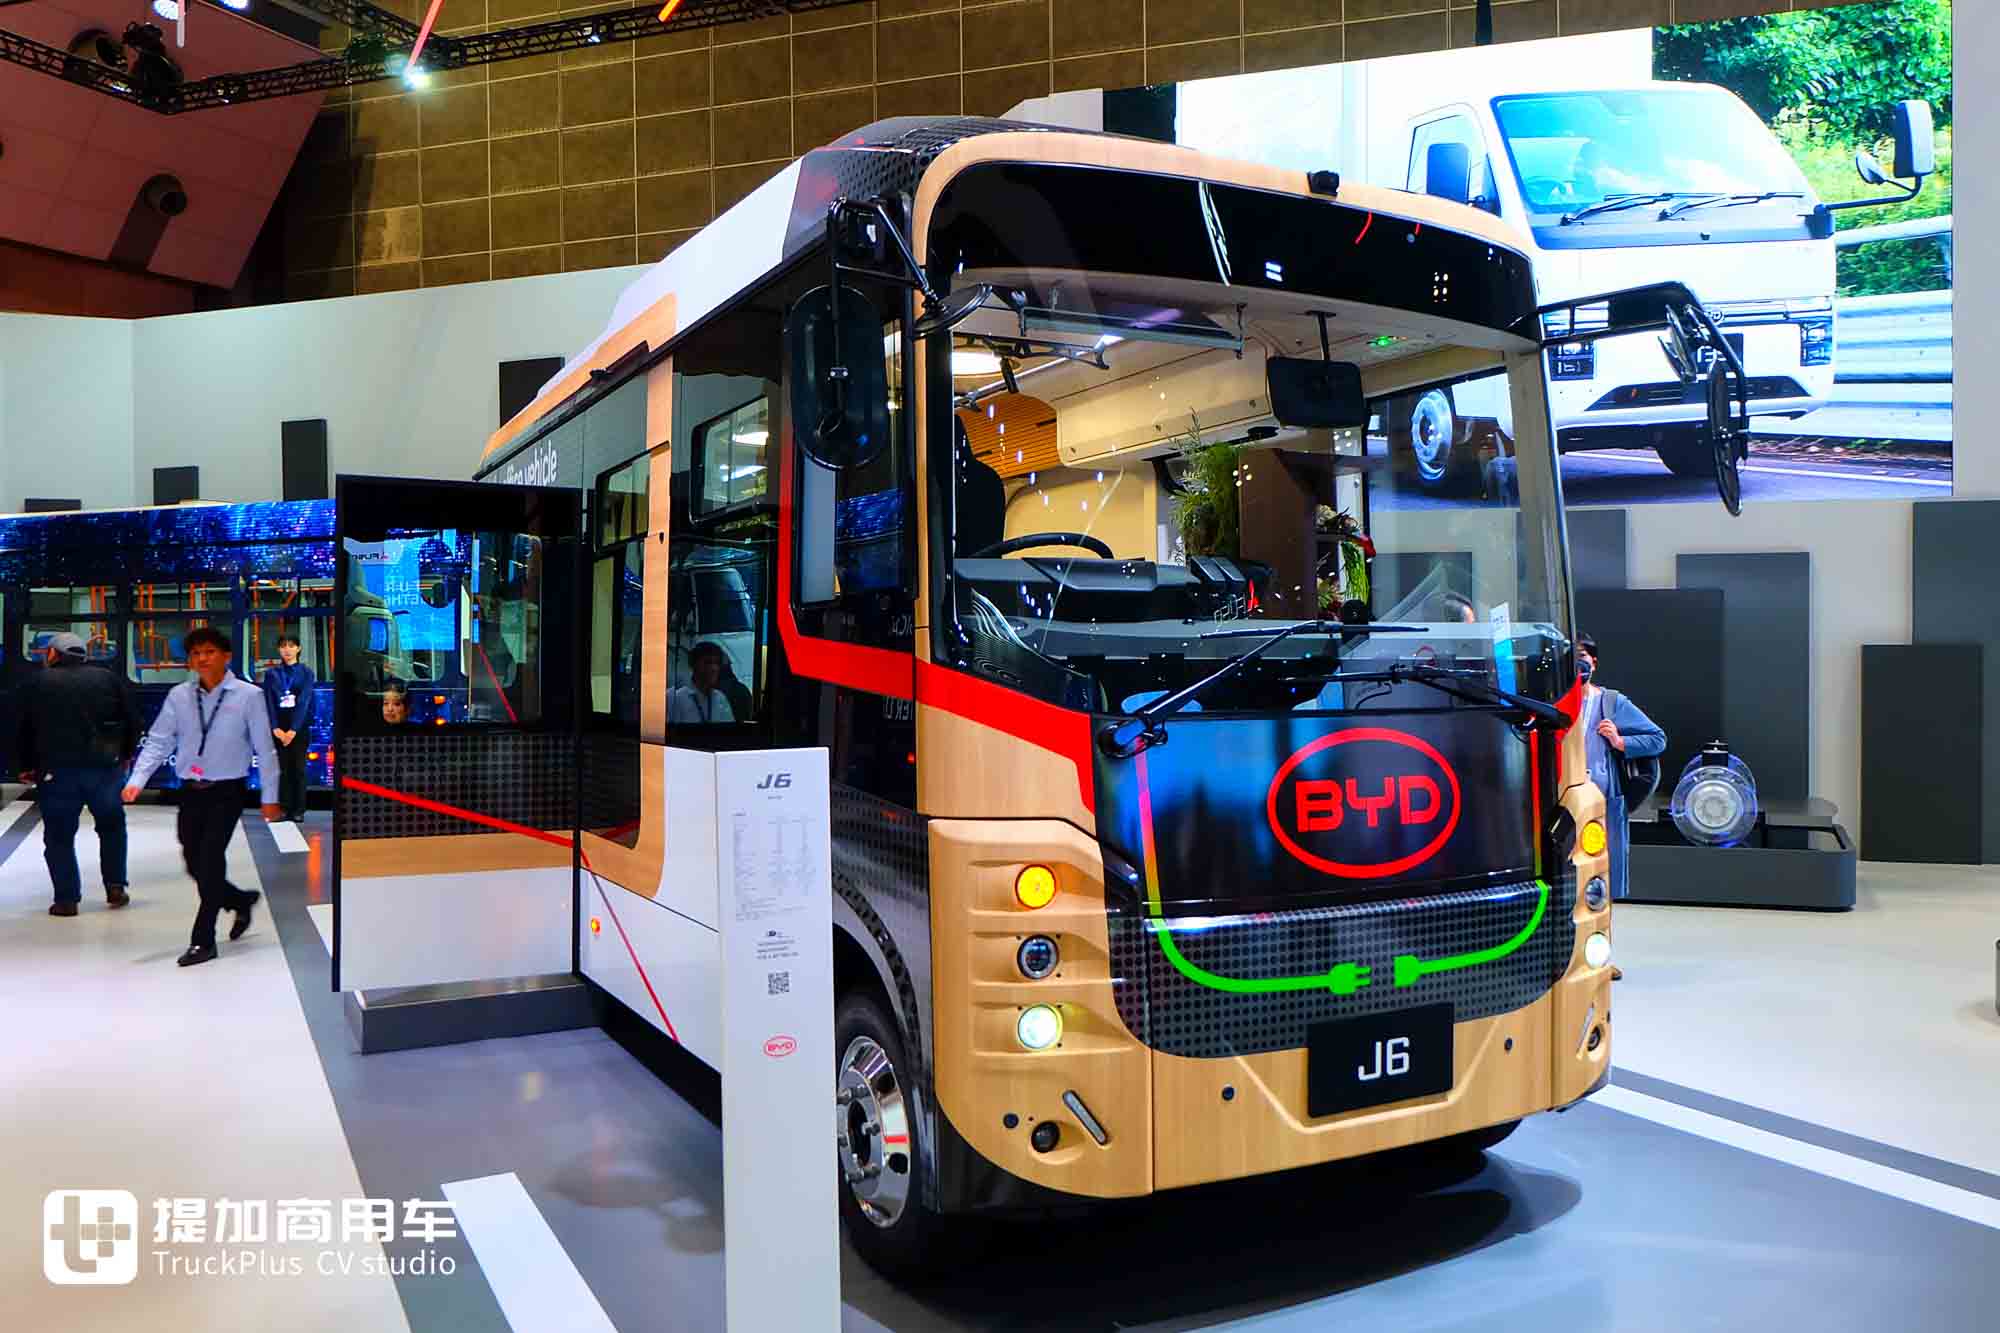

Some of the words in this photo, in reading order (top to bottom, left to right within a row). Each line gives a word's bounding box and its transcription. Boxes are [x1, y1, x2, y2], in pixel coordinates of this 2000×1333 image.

[757, 773, 792, 790] J6
[1295, 775, 1441, 833] BYD
[1358, 1036, 1410, 1081] J6
